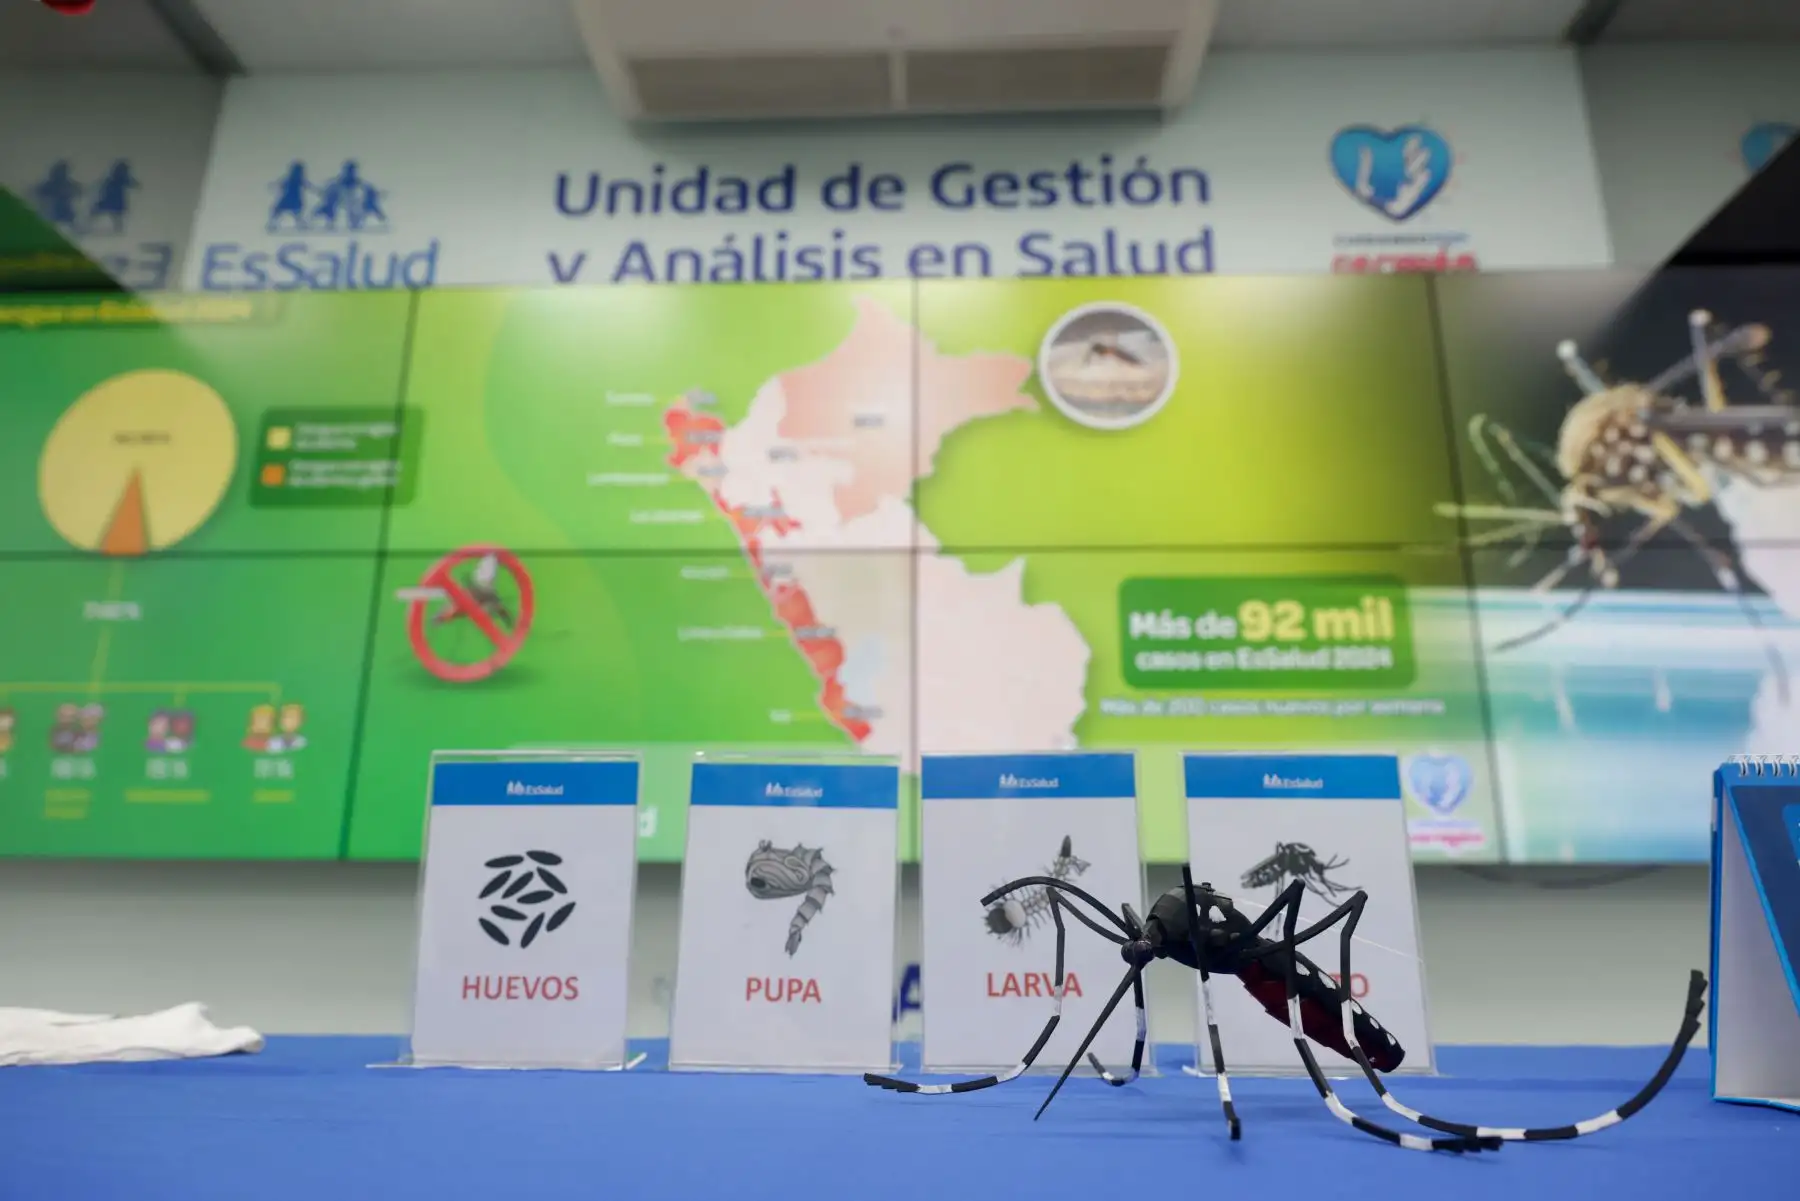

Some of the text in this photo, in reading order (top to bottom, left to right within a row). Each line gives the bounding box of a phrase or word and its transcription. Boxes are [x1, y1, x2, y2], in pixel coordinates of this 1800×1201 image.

[554, 153, 1213, 218] Unidad de Gestión
[201, 236, 440, 290] EsSalud
[610, 229, 881, 284] Análisis
[907, 241, 994, 279] en
[1017, 224, 1218, 279] Salud
[1128, 594, 1395, 642] Más de 92 mil
[1134, 651, 1201, 672] casos
[1203, 651, 1235, 671] en
[1236, 646, 1330, 671] EsSalud
[525, 783, 564, 796] EsSalud
[1019, 777, 1059, 789] EsSalud
[462, 975, 580, 1001] HUEVOS
[745, 977, 821, 1003] PUPA
[987, 972, 1083, 998] LARVA
